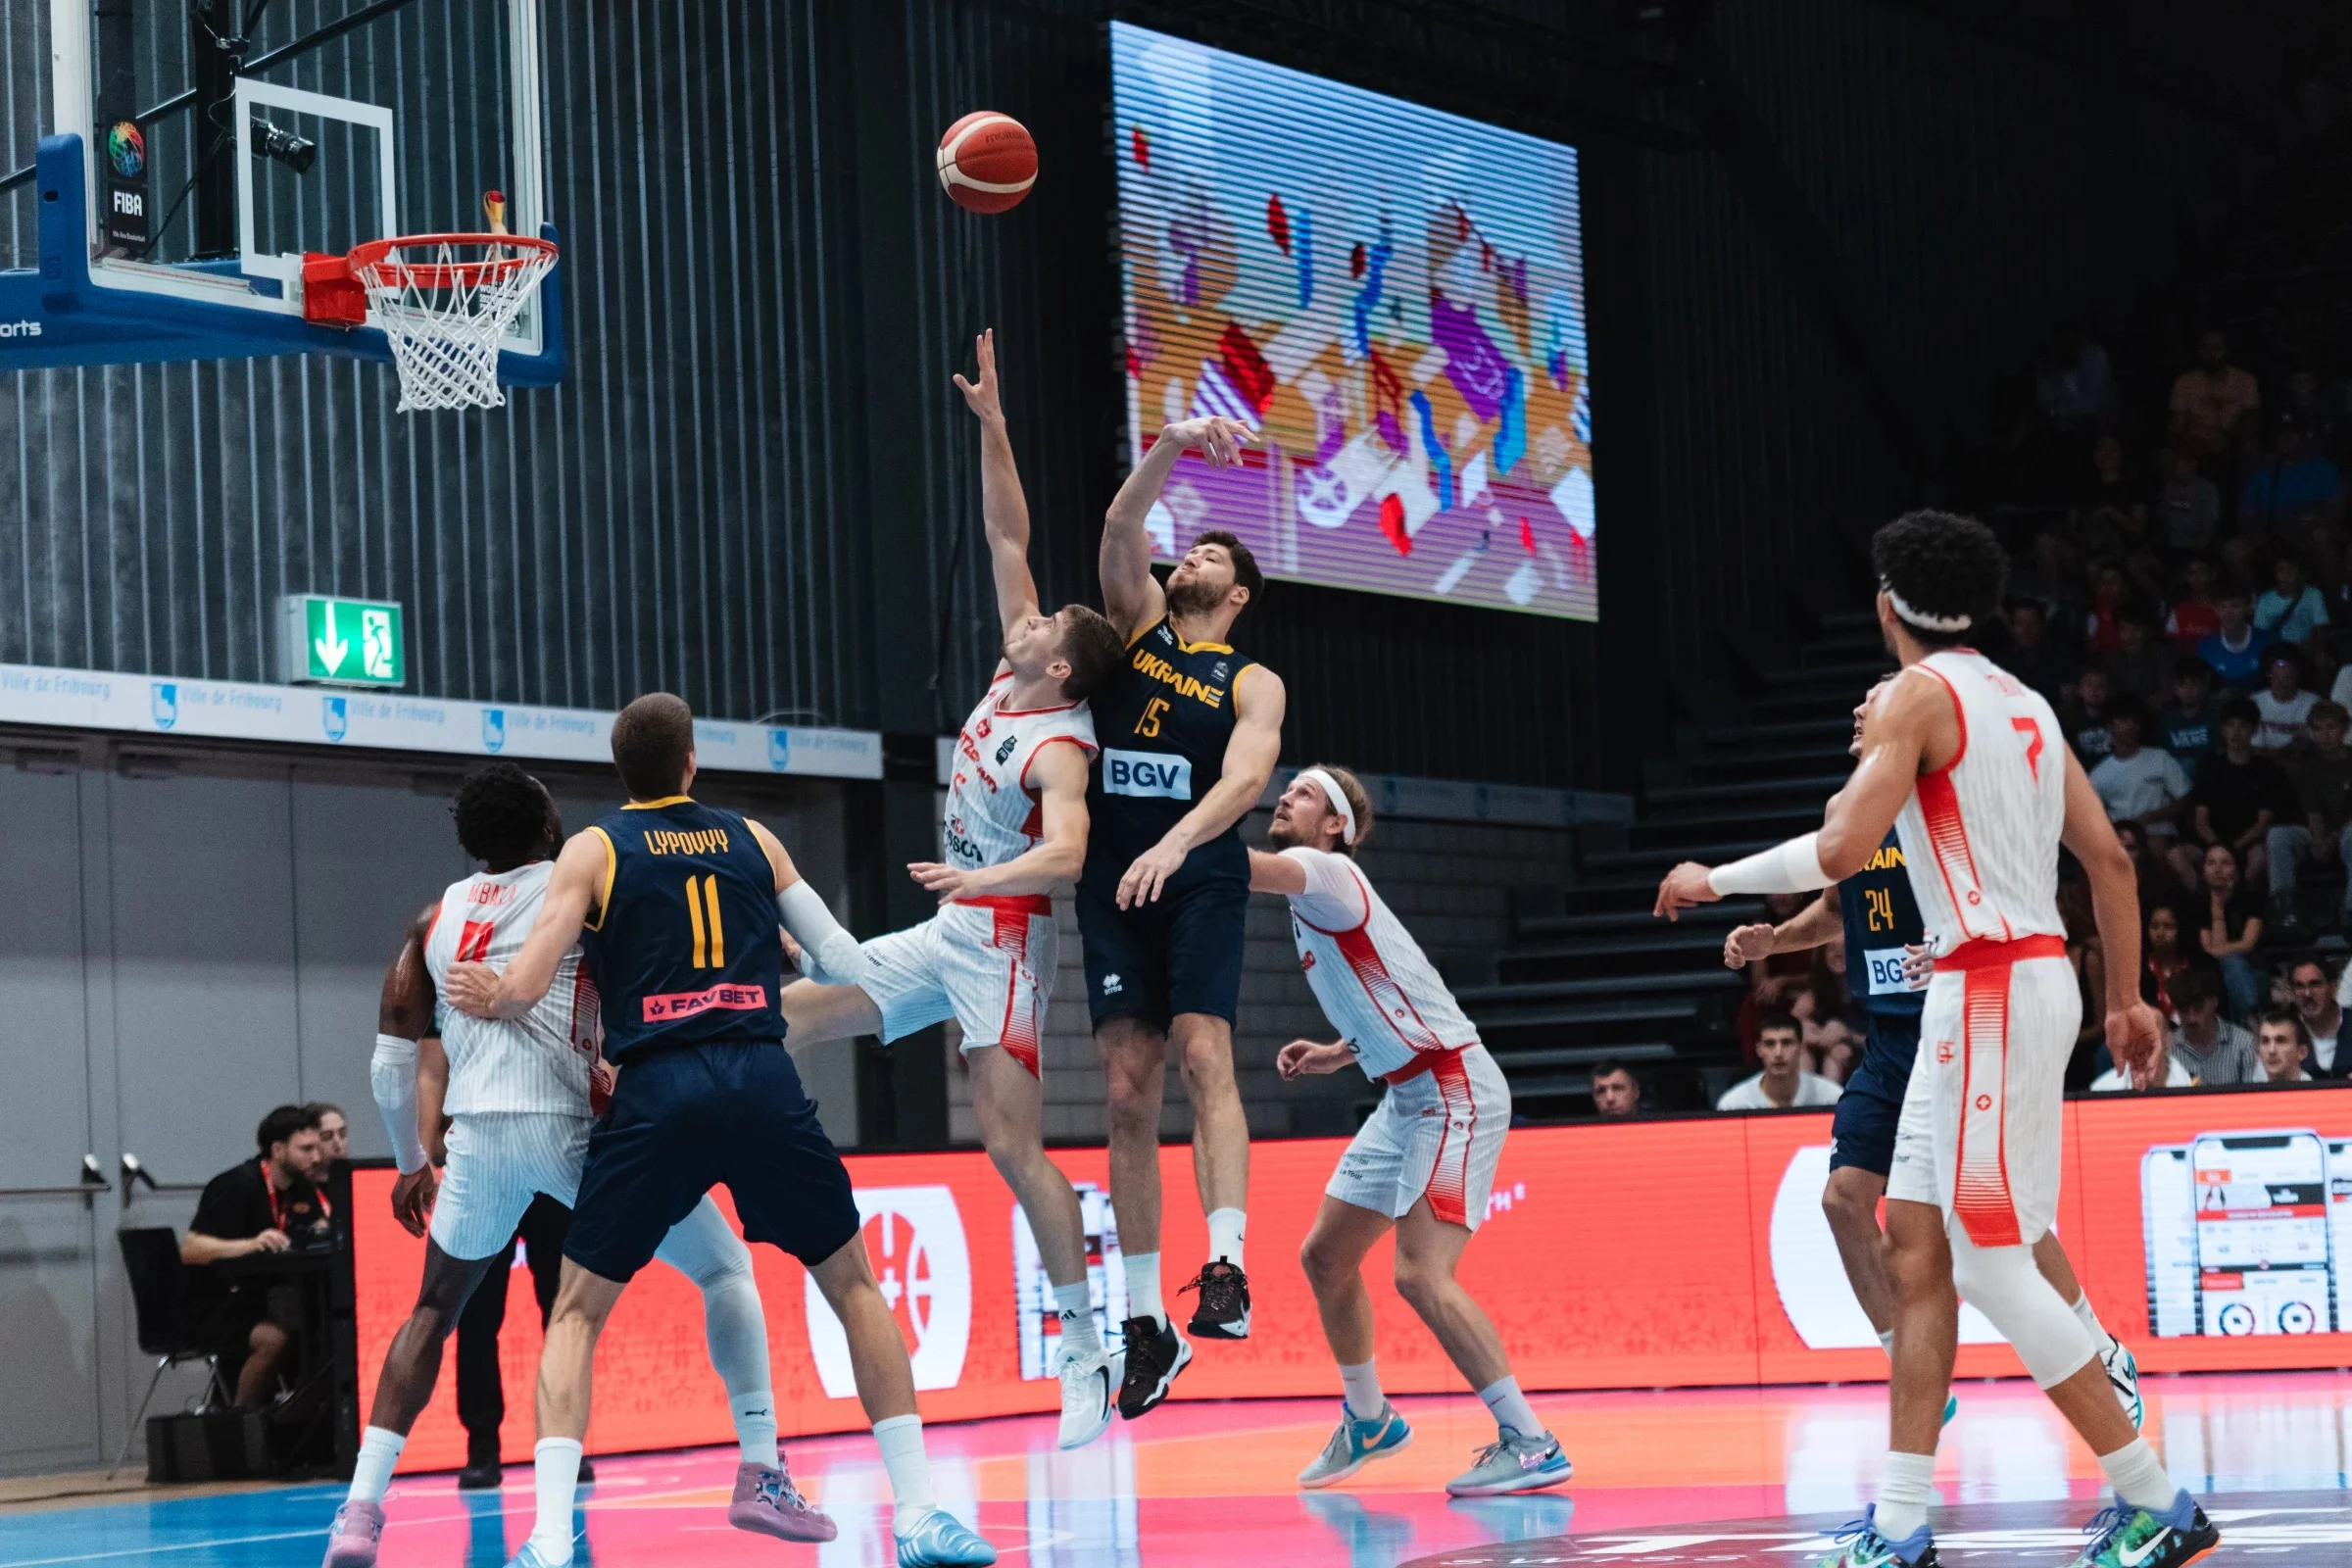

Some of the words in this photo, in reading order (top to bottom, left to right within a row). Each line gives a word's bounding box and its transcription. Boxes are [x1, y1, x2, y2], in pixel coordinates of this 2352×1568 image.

[114, 190, 142, 217] FIBA
[0, 319, 42, 338] orts
[35, 675, 48, 692] de
[55, 674, 110, 702] Fribourg
[1132, 648, 1225, 709] UKRAINE
[213, 690, 225, 706] de
[230, 688, 282, 713] Fribourg
[379, 702, 392, 719] de
[396, 702, 444, 726] Fribourg
[1134, 697, 1171, 738] 15
[2009, 716, 2044, 792] 7
[1110, 760, 1180, 790] BGV
[644, 828, 729, 856] LYPOVYY
[686, 873, 724, 968] 11
[1865, 888, 1894, 932] 24
[670, 989, 760, 1013] FAVBET
[1348, 1169, 1363, 1181] Tour
